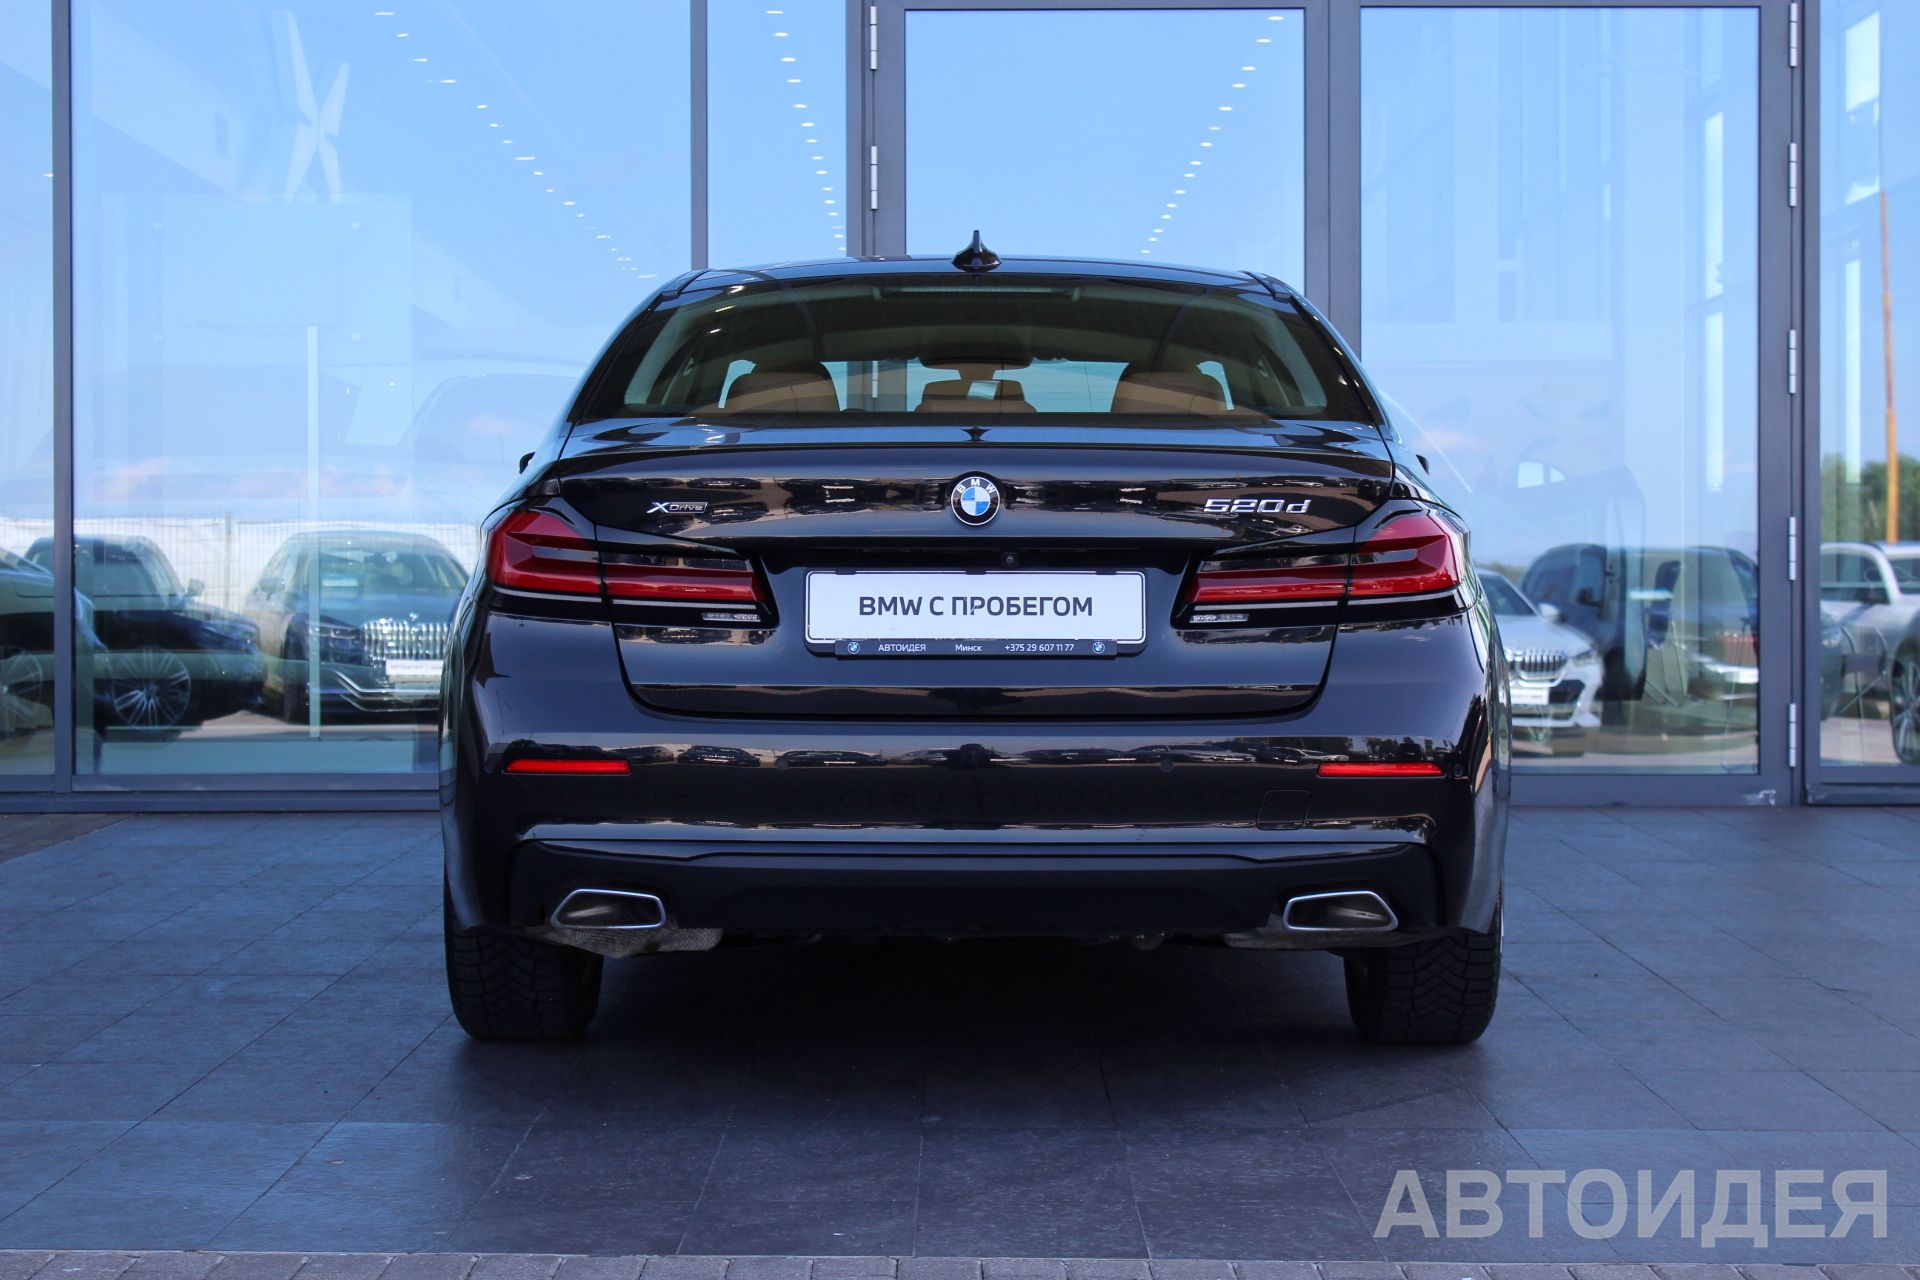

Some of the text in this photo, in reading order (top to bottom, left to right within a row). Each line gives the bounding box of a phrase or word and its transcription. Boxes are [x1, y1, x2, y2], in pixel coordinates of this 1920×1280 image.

[956, 478, 996, 494] BMW
[1203, 498, 1312, 514] 520d
[859, 596, 1093, 616] BMW С ПРОБЕГОМ
[878, 643, 927, 653] АВТОИДЕЯ
[955, 643, 983, 653] Минск
[1004, 643, 1075, 652] +375 29 607 11 77
